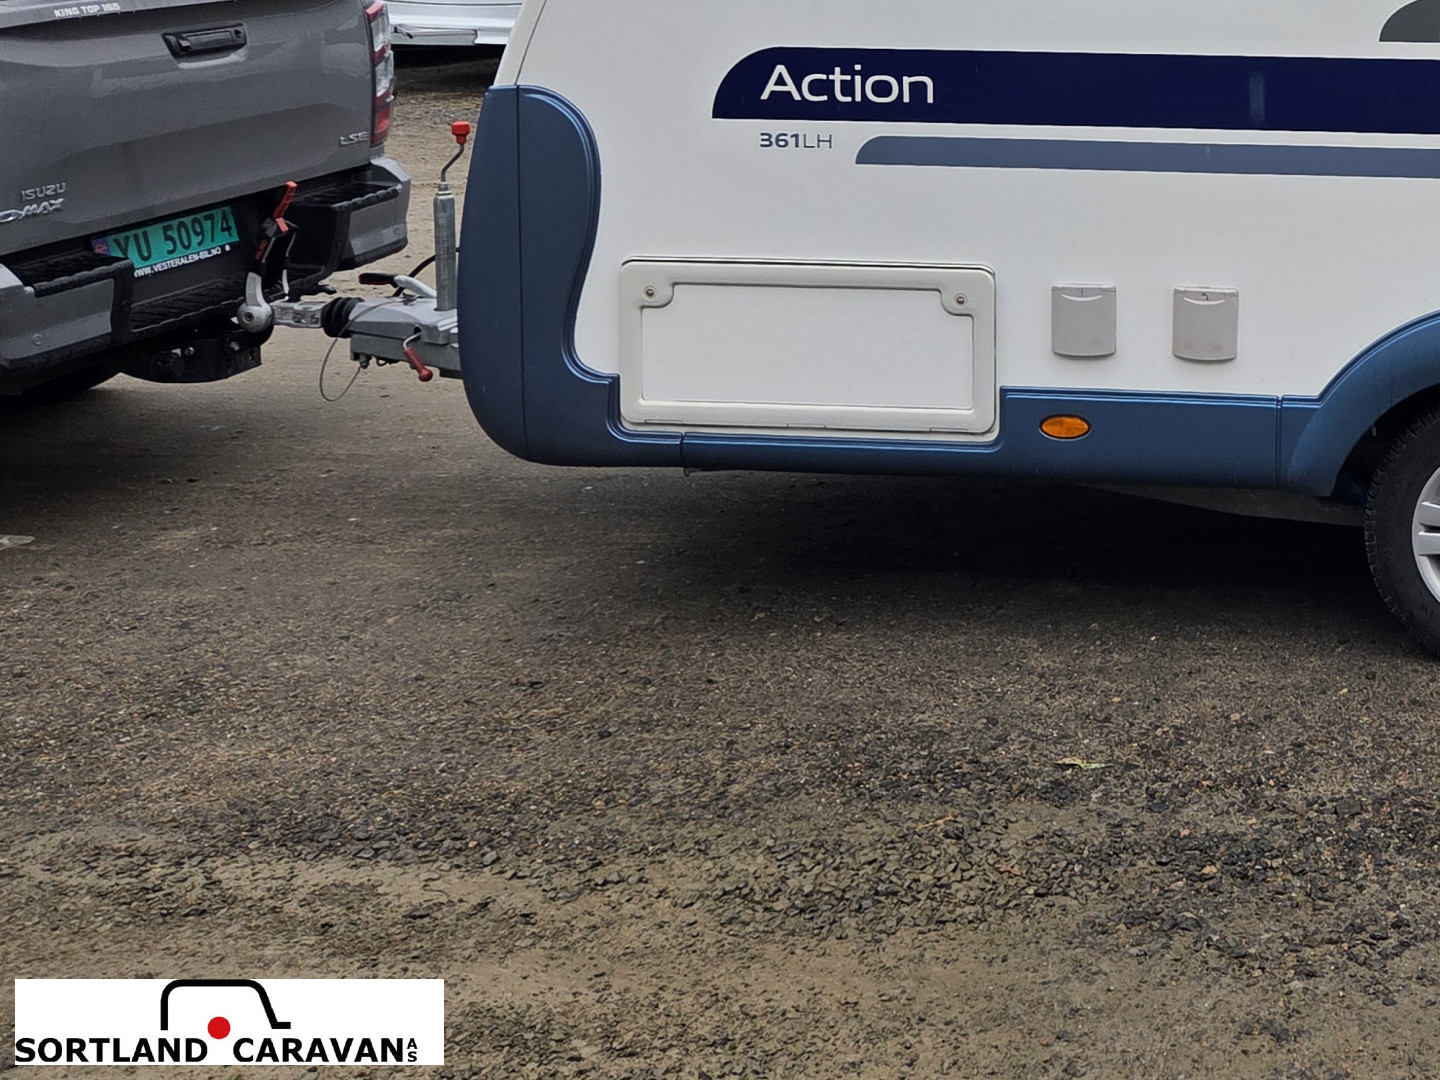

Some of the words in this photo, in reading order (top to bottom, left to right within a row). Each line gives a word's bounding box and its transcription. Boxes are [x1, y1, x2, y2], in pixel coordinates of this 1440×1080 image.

[54, 6, 80, 18] KING
[80, 4, 100, 15] TOP
[760, 64, 934, 104] Action
[340, 131, 369, 145] LSE
[759, 132, 833, 149] 361LH
[21, 182, 66, 201] ISUZU
[113, 231, 152, 262] YU
[162, 210, 232, 255] 50974
